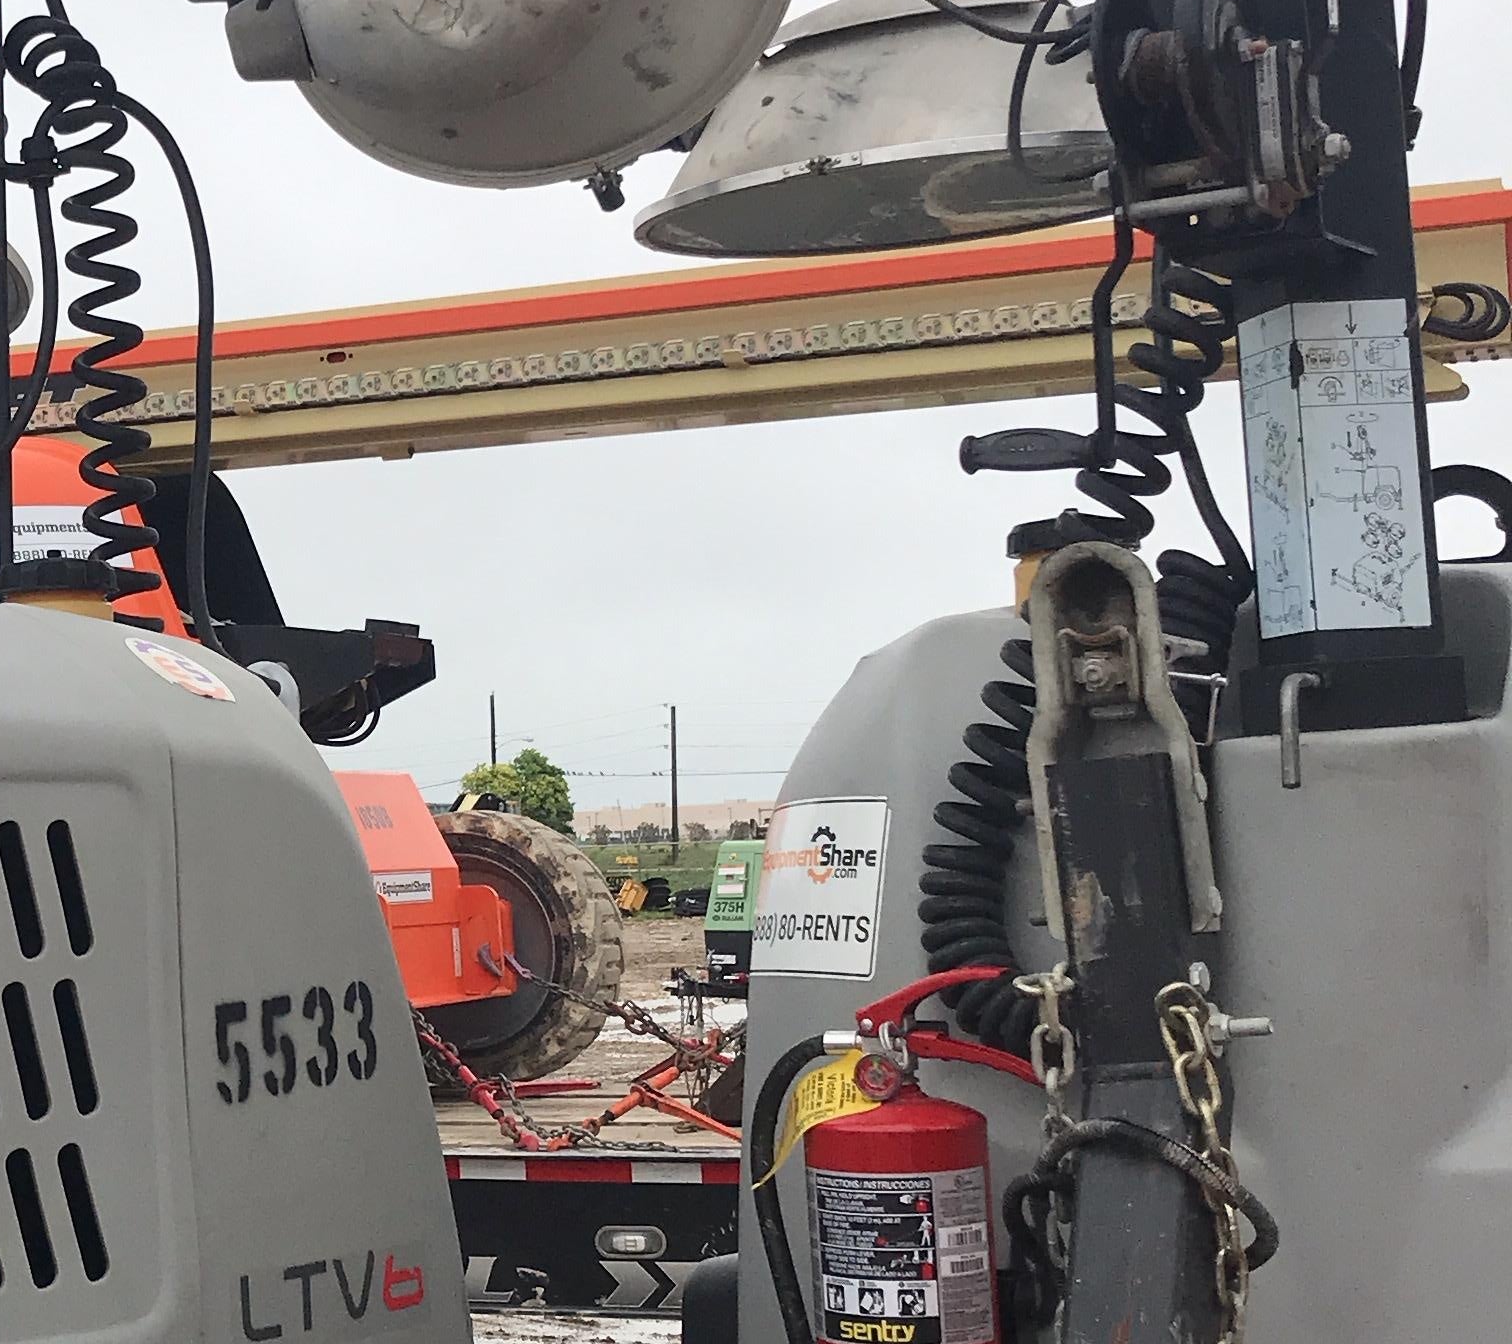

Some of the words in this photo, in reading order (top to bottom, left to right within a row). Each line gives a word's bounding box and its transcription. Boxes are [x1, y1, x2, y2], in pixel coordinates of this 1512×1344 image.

[713, 901, 745, 913] 375H
[215, 981, 377, 1104] 5533
[240, 1250, 425, 1342] LTV6
[839, 1319, 916, 1343] sentry
